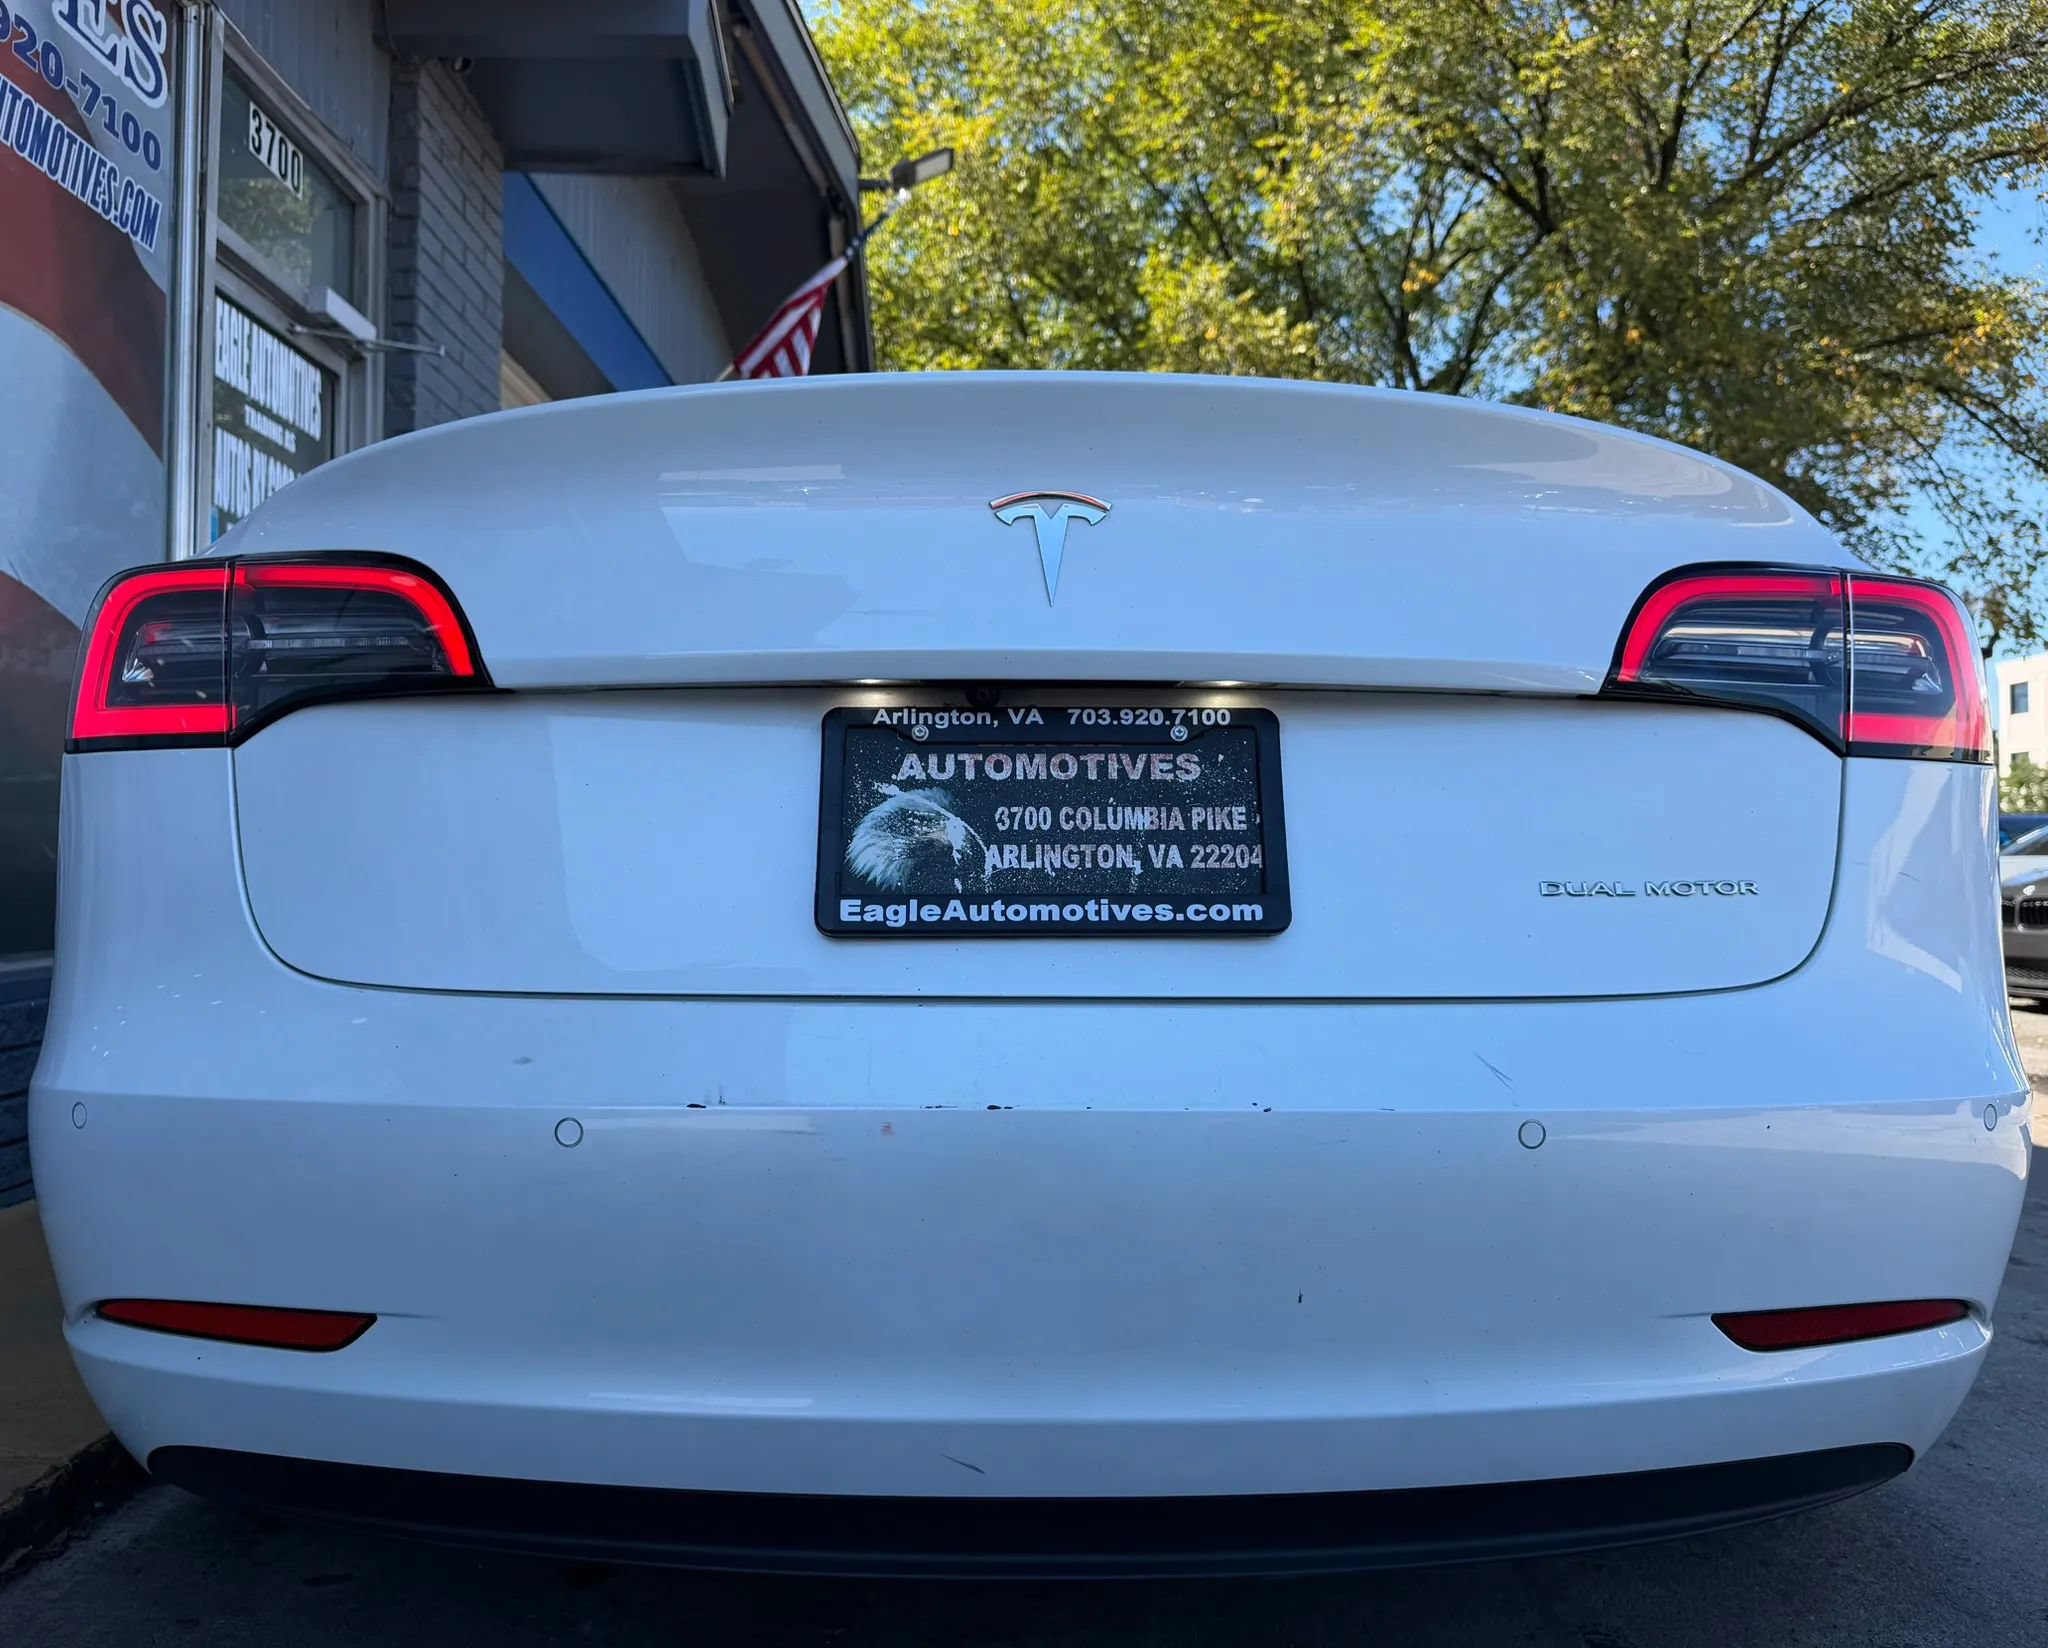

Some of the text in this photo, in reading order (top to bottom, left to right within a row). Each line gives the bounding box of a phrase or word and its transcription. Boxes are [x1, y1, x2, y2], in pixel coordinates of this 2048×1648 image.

[252, 108, 300, 193] 3700
[214, 296, 322, 441] EAGLE AUTOMOTIVES
[873, 708, 1231, 729] Arlington, VA 703.920.7100
[897, 752, 1202, 781] AUTOMOTIVES
[995, 805, 1248, 831] 3700 COLUMBIA PIKE
[985, 844, 1264, 874] ARLINGTON, VA 22204
[1540, 880, 1760, 897] DUAL MOTOR
[840, 899, 1264, 928] EagleAutomotives.com
